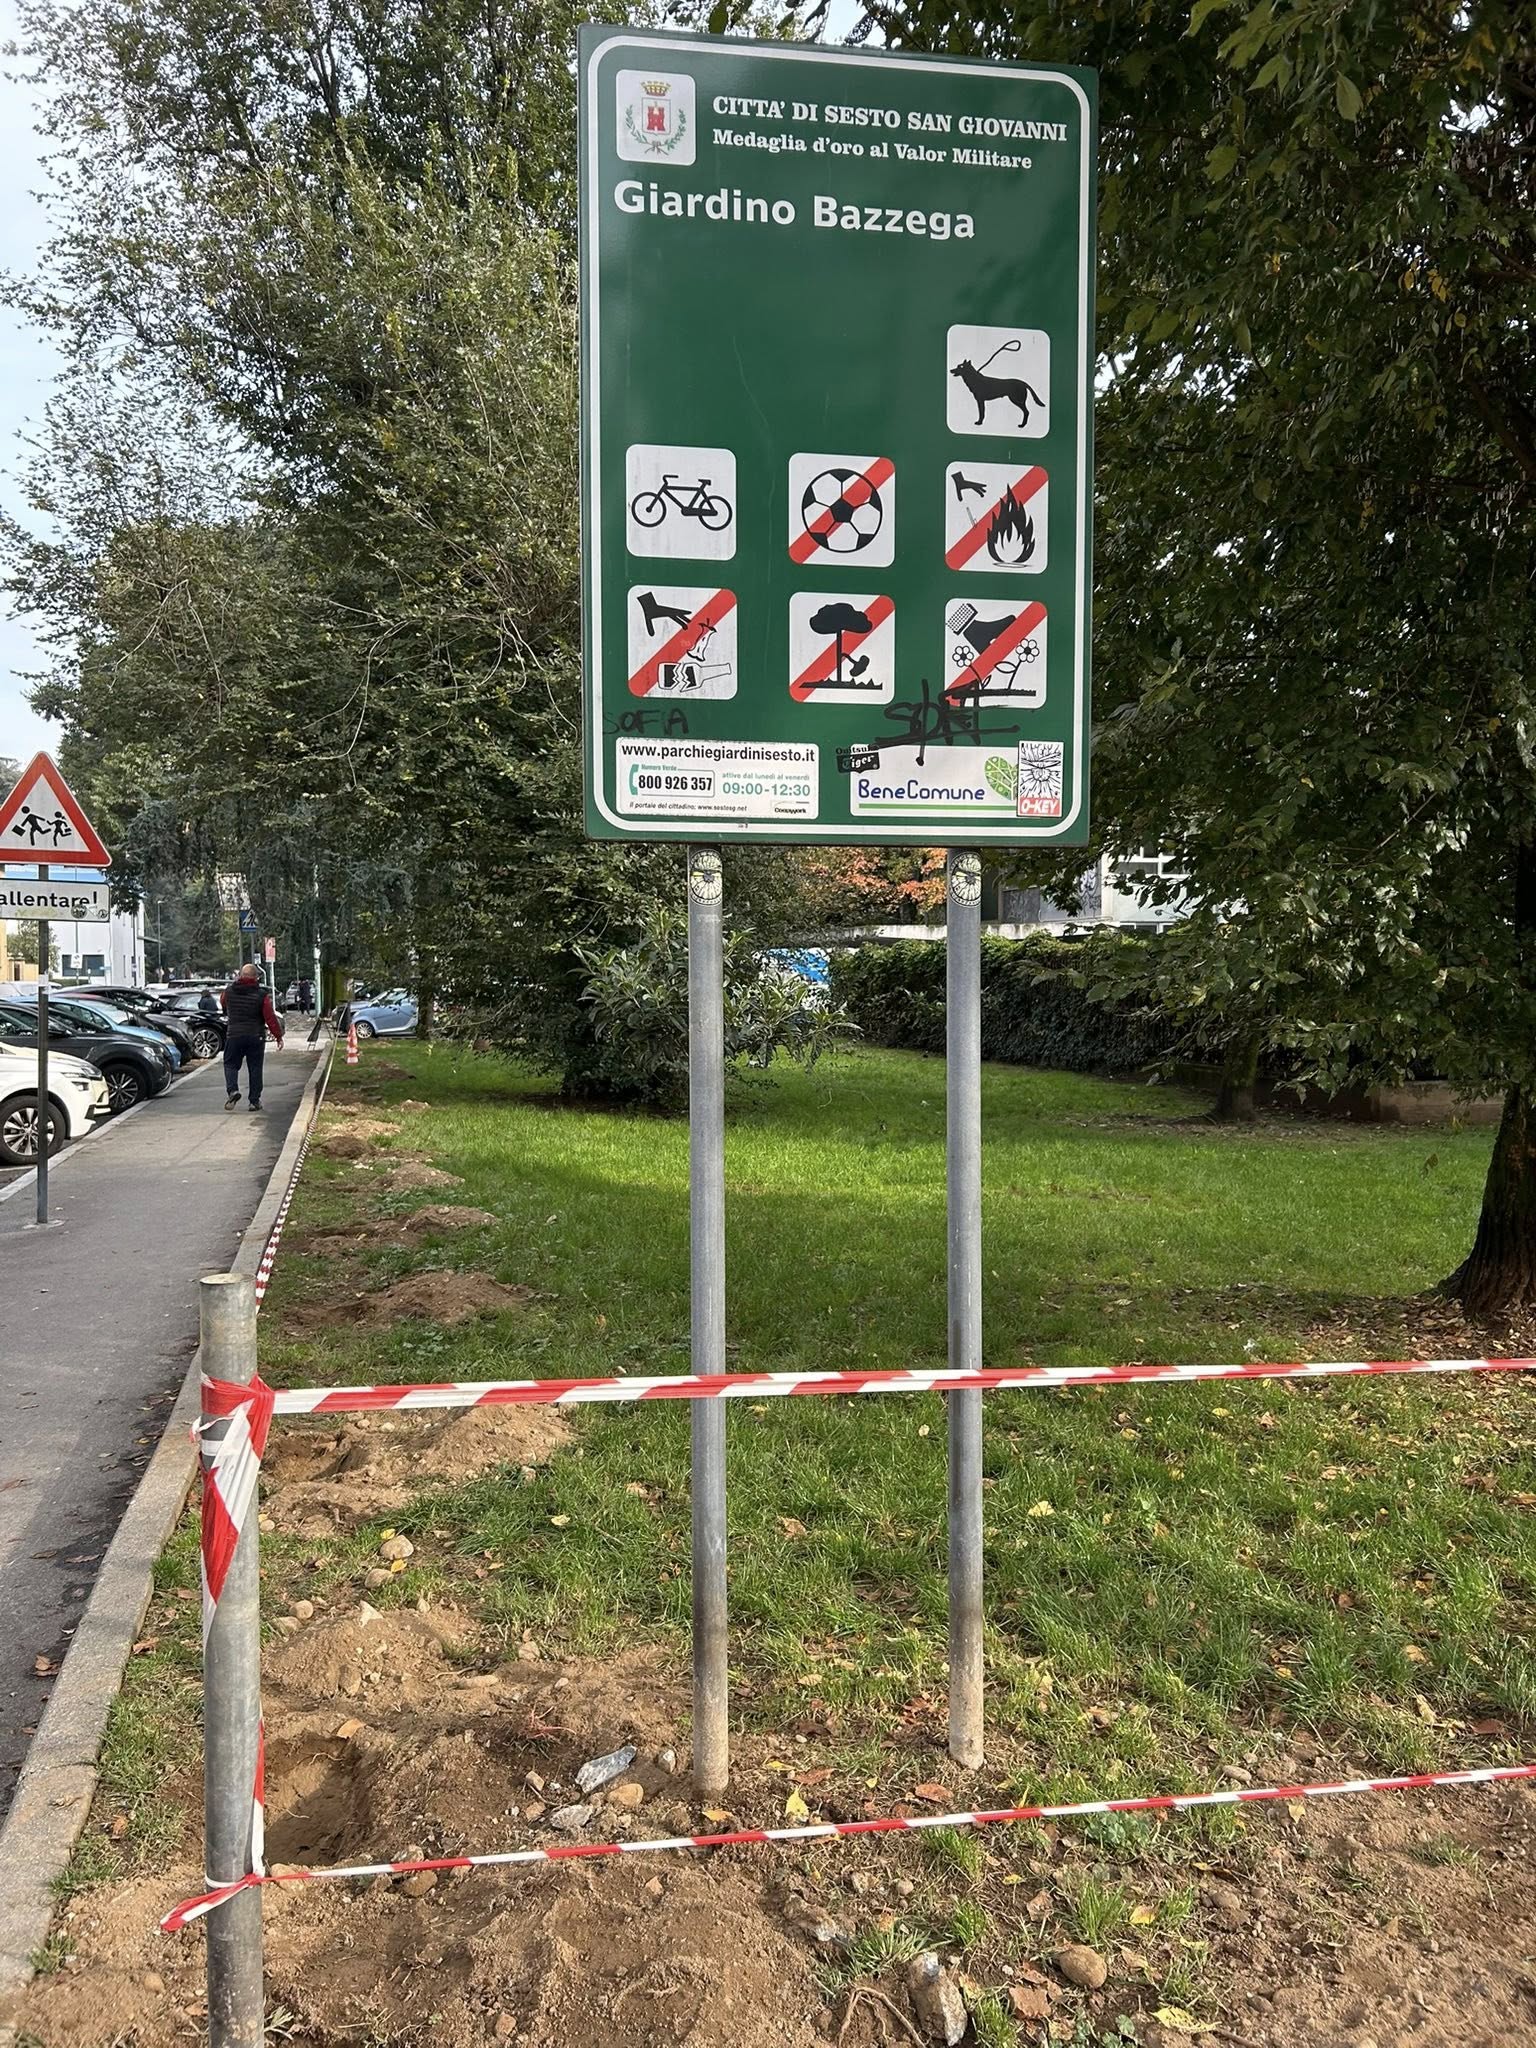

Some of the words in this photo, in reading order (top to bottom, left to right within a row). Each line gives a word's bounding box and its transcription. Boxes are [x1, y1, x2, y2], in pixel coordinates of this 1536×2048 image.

[713, 96, 786, 120] CITTA'
[792, 102, 819, 122] DI
[824, 104, 901, 128] SESTO
[907, 111, 953, 133] SAN
[958, 115, 1068, 142] GIOVANNI
[713, 128, 807, 153] Medaglia
[813, 135, 864, 157] d'oro
[870, 139, 889, 159] al
[894, 142, 947, 164] Valor
[952, 147, 1032, 170] Militare
[613, 179, 796, 226] Giardino
[814, 196, 976, 241] Bazzega
[621, 744, 816, 762] www.parchiegiardinisesto.it
[638, 775, 662, 790] 800
[665, 775, 688, 790] 926
[691, 776, 713, 791] 357
[858, 778, 985, 800] BeneComune
[1020, 799, 1058, 814] O-KEY
